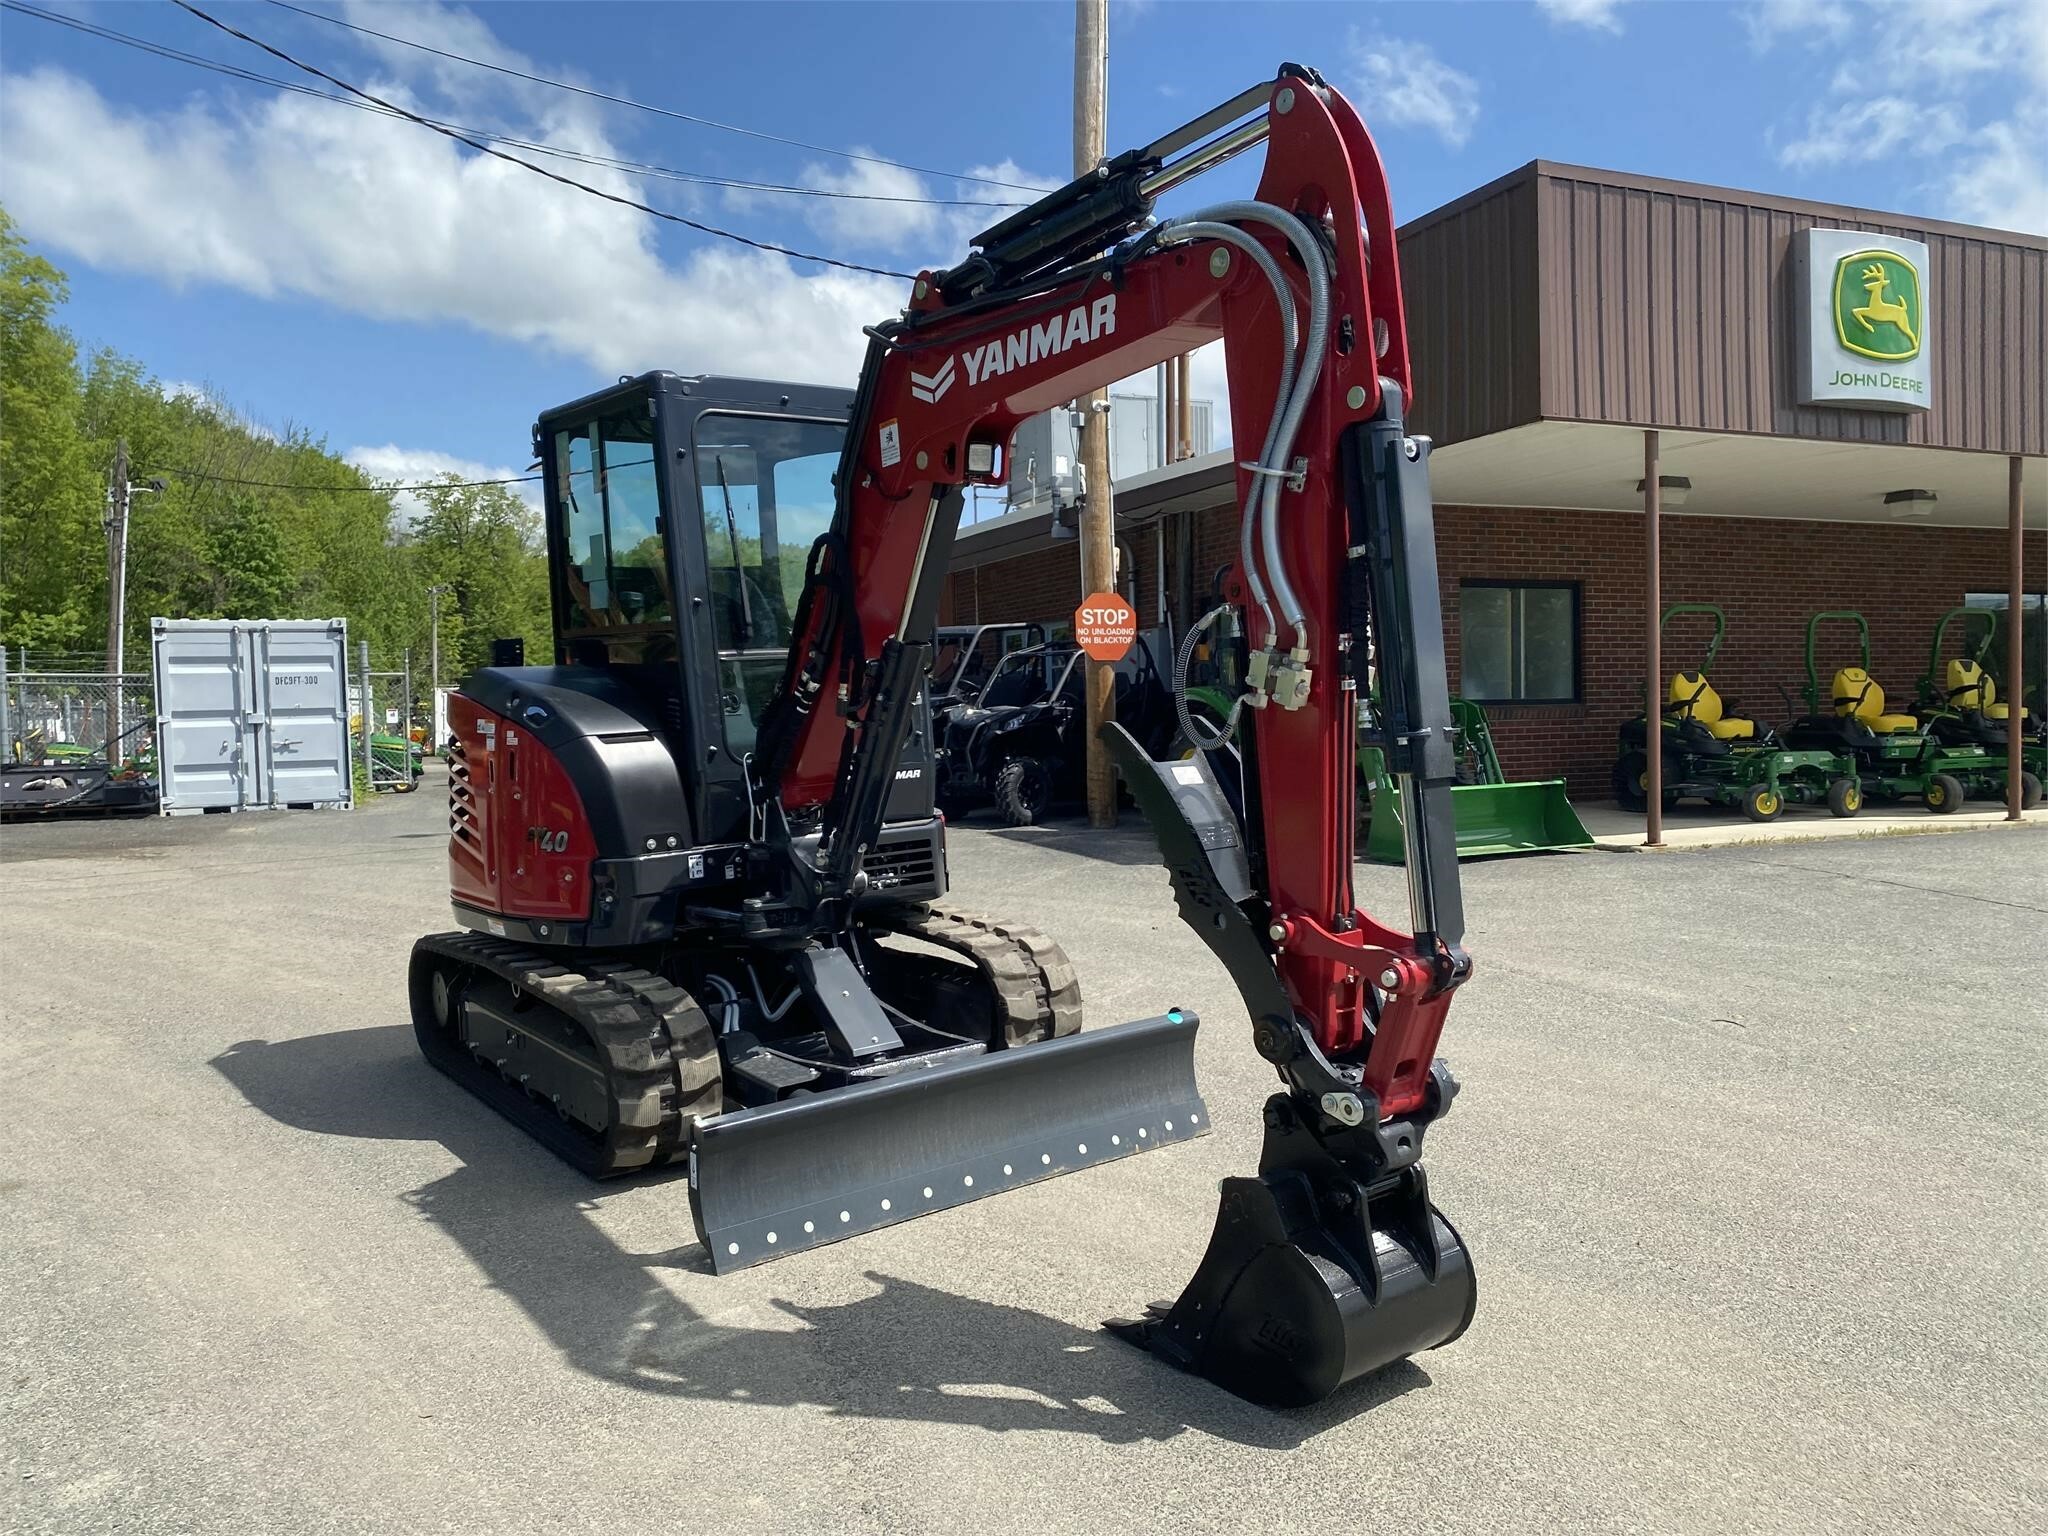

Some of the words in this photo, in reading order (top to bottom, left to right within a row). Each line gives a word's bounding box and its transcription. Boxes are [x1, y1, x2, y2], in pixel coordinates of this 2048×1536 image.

[962, 294, 1117, 386] YANMAR
[1829, 370, 1877, 386] JOHN
[1880, 372, 1924, 393] DEERE
[1081, 608, 1129, 625] STOP
[1077, 627, 1089, 635] NO
[1091, 627, 1135, 636] UNLOADING
[1080, 636, 1091, 644] ON
[1093, 636, 1133, 644] BLACKTOP
